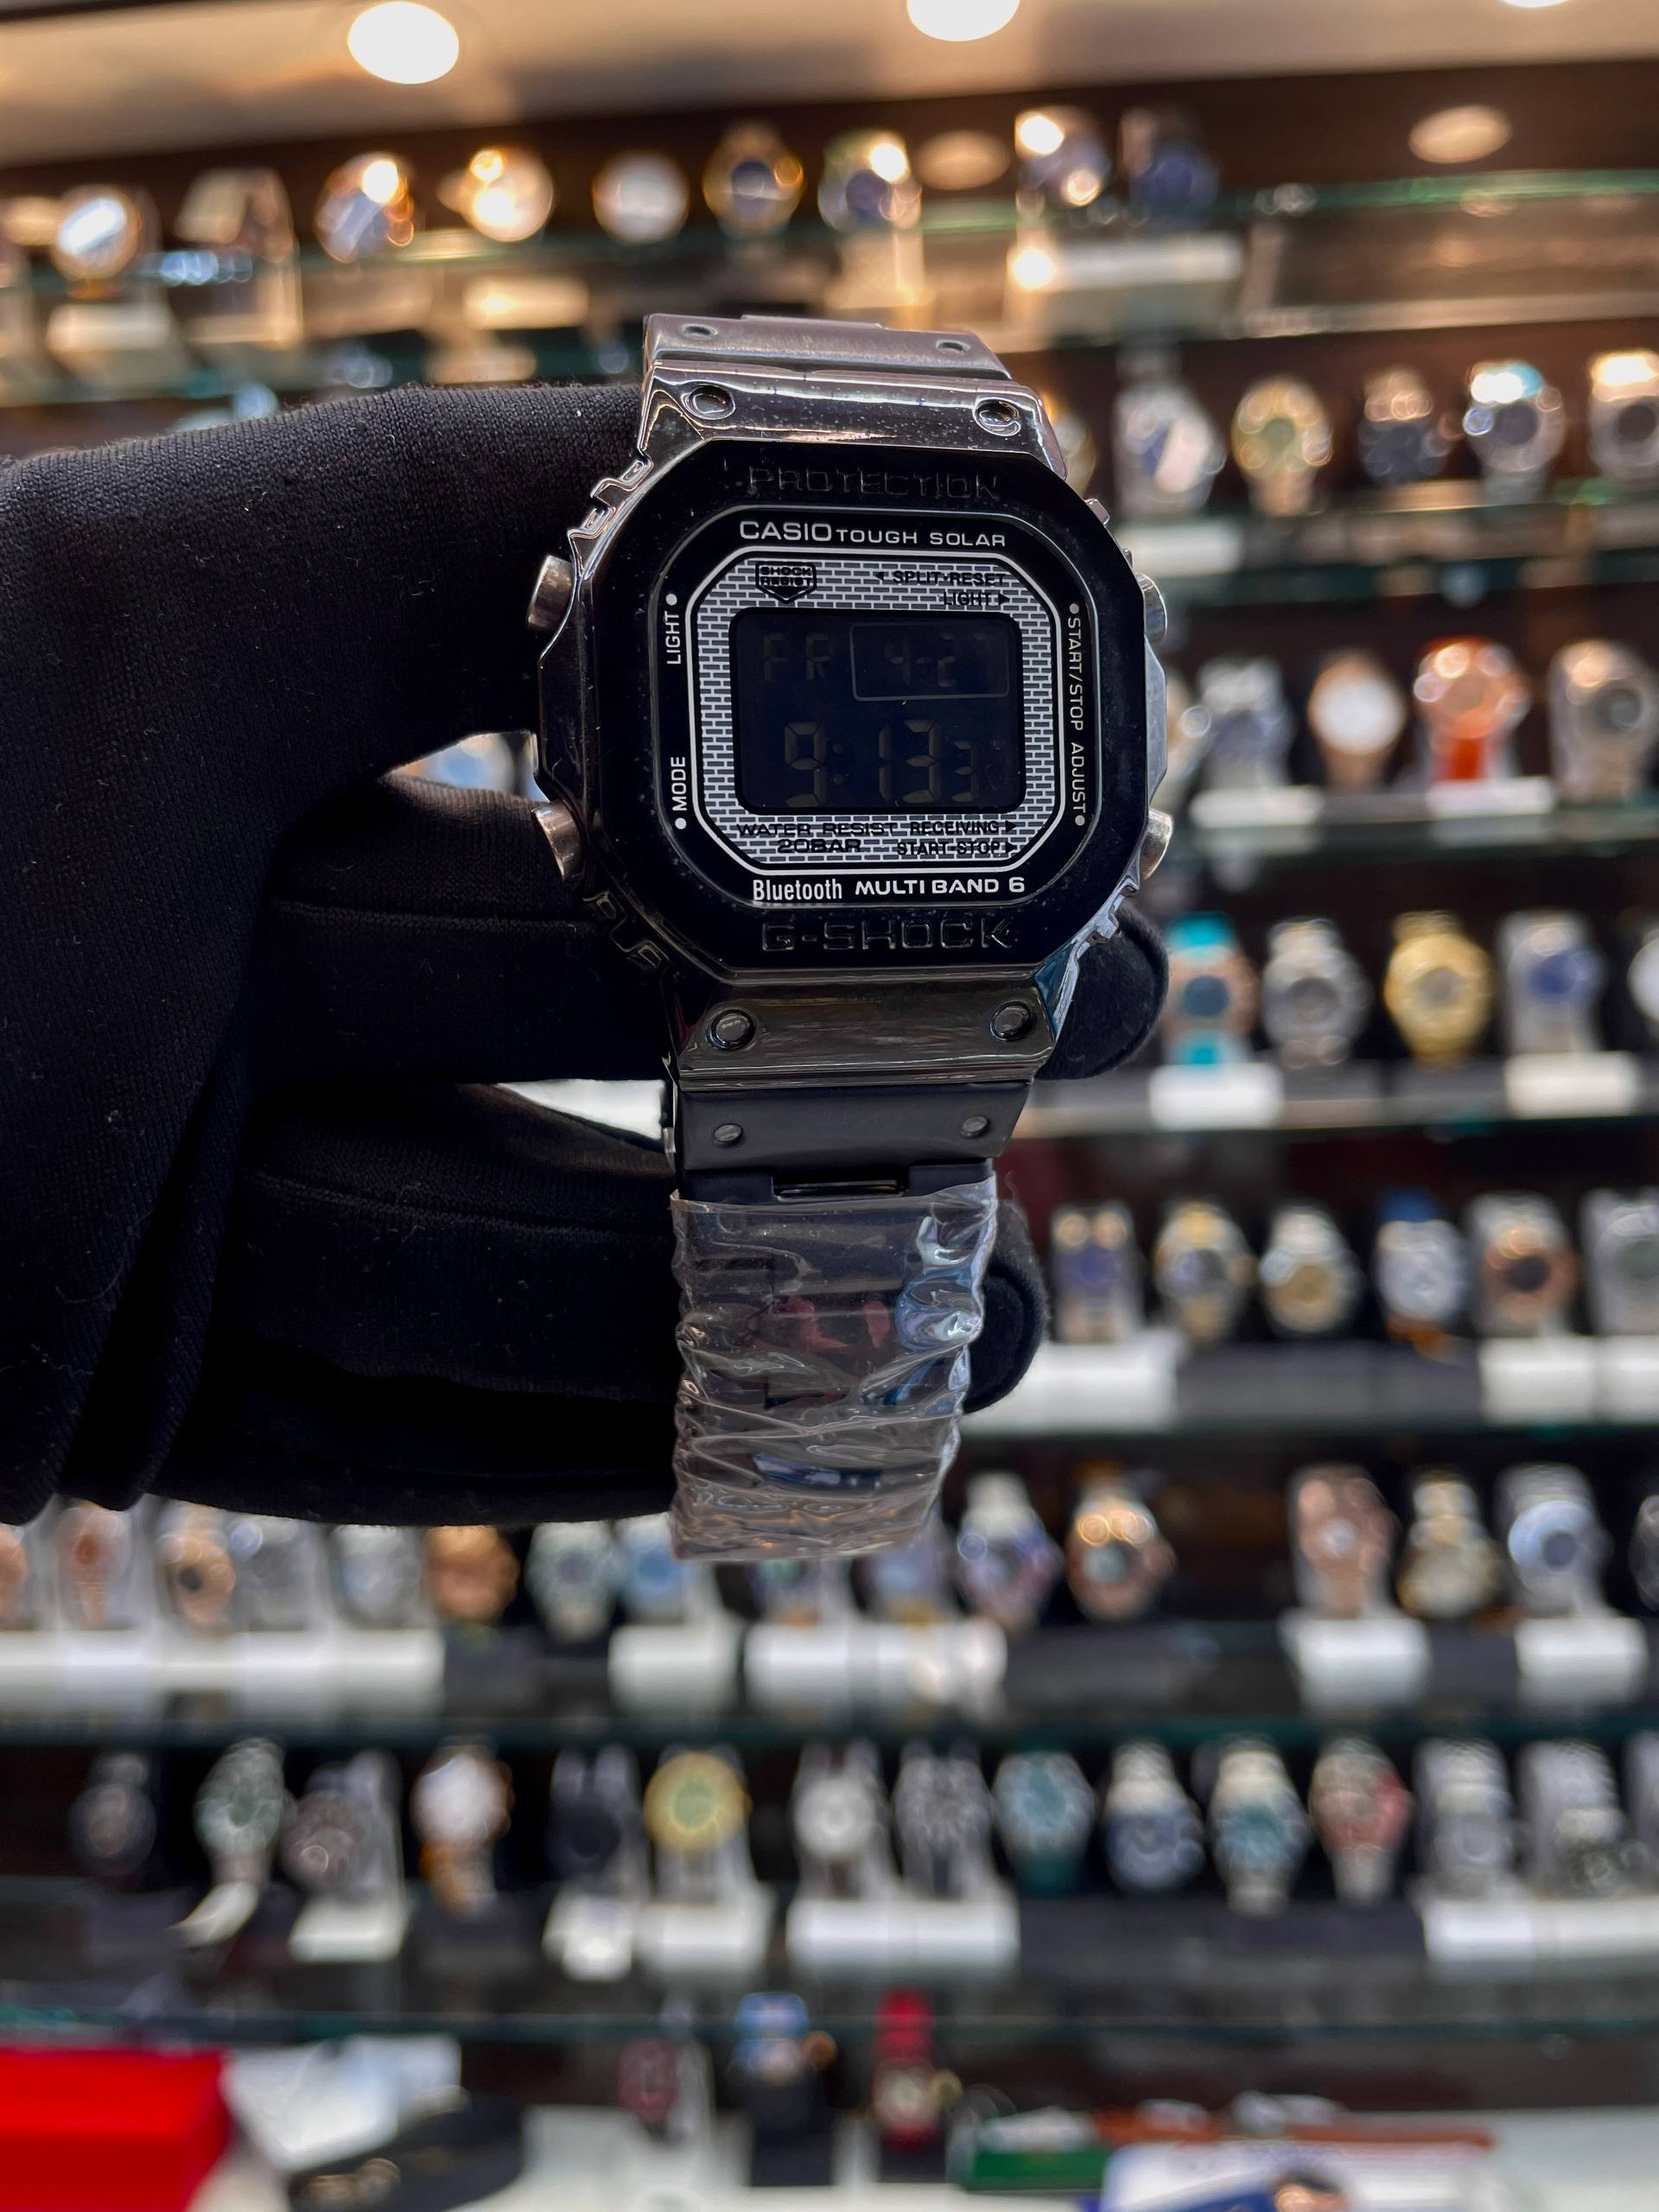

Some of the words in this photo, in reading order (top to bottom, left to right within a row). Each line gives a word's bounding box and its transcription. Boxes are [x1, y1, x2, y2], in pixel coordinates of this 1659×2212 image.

[748, 465, 999, 500] PROTECTION
[740, 521, 832, 542] CASIO
[836, 529, 918, 544] TOUGH
[930, 531, 1006, 547] SOLAR
[760, 565, 812, 576] SHOCK
[760, 576, 812, 588] RESIST
[944, 591, 995, 607] LIGHT
[664, 611, 682, 664] LIGHT
[1068, 617, 1084, 731] START/STOP
[671, 756, 687, 811] MODE
[1071, 741, 1086, 814] ADJUST
[736, 823, 811, 837] WATER
[822, 823, 897, 836] RESIST
[910, 820, 1000, 836] RECEIVING
[777, 838, 861, 854] 20BAR
[753, 878, 842, 901] Bluetooth
[855, 880, 925, 895] MULTI
[931, 879, 1000, 893] BAND
[1008, 876, 1026, 893] 6
[760, 918, 1014, 951] G-SHOCK
